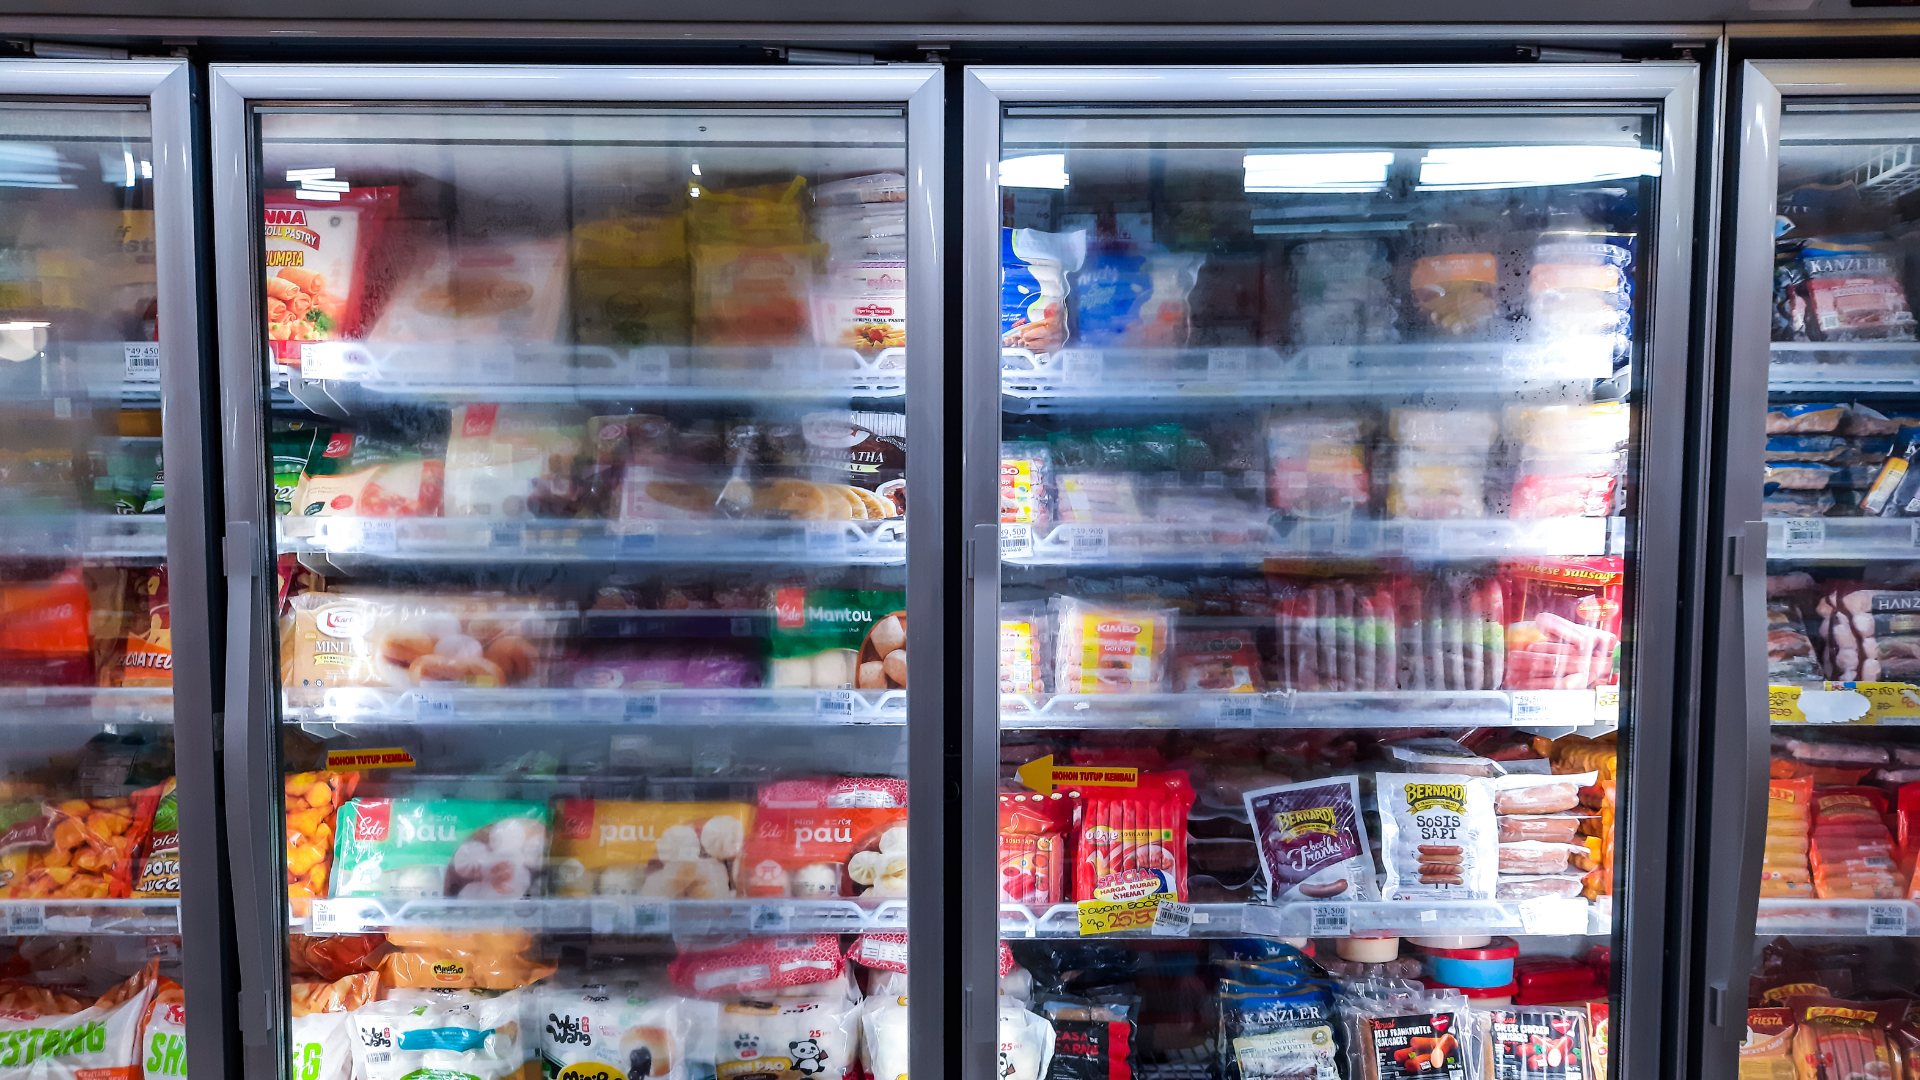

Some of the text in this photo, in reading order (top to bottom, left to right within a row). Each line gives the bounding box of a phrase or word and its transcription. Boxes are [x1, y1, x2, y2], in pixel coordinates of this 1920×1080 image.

[285, 227, 317, 246] PASTRY
[1809, 257, 1888, 272] KANZLER
[326, 440, 347, 453] Edo
[1517, 563, 1616, 582] Cheese Sausage
[808, 606, 873, 622] Mantou
[1097, 624, 1142, 634] KIMBO
[315, 641, 345, 653] MINI
[1104, 645, 1131, 654] Goreng
[328, 756, 356, 766] MOHON
[356, 755, 381, 764] TUTUP
[1052, 771, 1136, 782] MOHON TUTUP KEMBALI
[1404, 783, 1467, 804] BERNARDI
[1276, 807, 1337, 833] BERNARDI
[360, 816, 457, 848] Edo pau
[599, 824, 656, 847] pau
[760, 822, 853, 848] Edo pau
[1421, 828, 1457, 839] SAPI
[1308, 835, 1331, 850] beef
[1097, 868, 1158, 889] SPECIAL
[1100, 880, 1157, 895] HARGA MURAH
[1119, 889, 1146, 898] HEMAT
[1317, 907, 1345, 915] 83,500
[1243, 1006, 1321, 1025] KANZLER
[1752, 1016, 1784, 1026] FIESTA
[549, 1014, 580, 1032] Wei
[546, 1025, 592, 1047] Wang
[809, 1029, 821, 1038] 25
[1390, 1026, 1432, 1038] FRANKFURTER
[1000, 1042, 1013, 1051] 25
[1378, 1036, 1408, 1047] SAUSAGES
[755, 1060, 786, 1073] PAO
